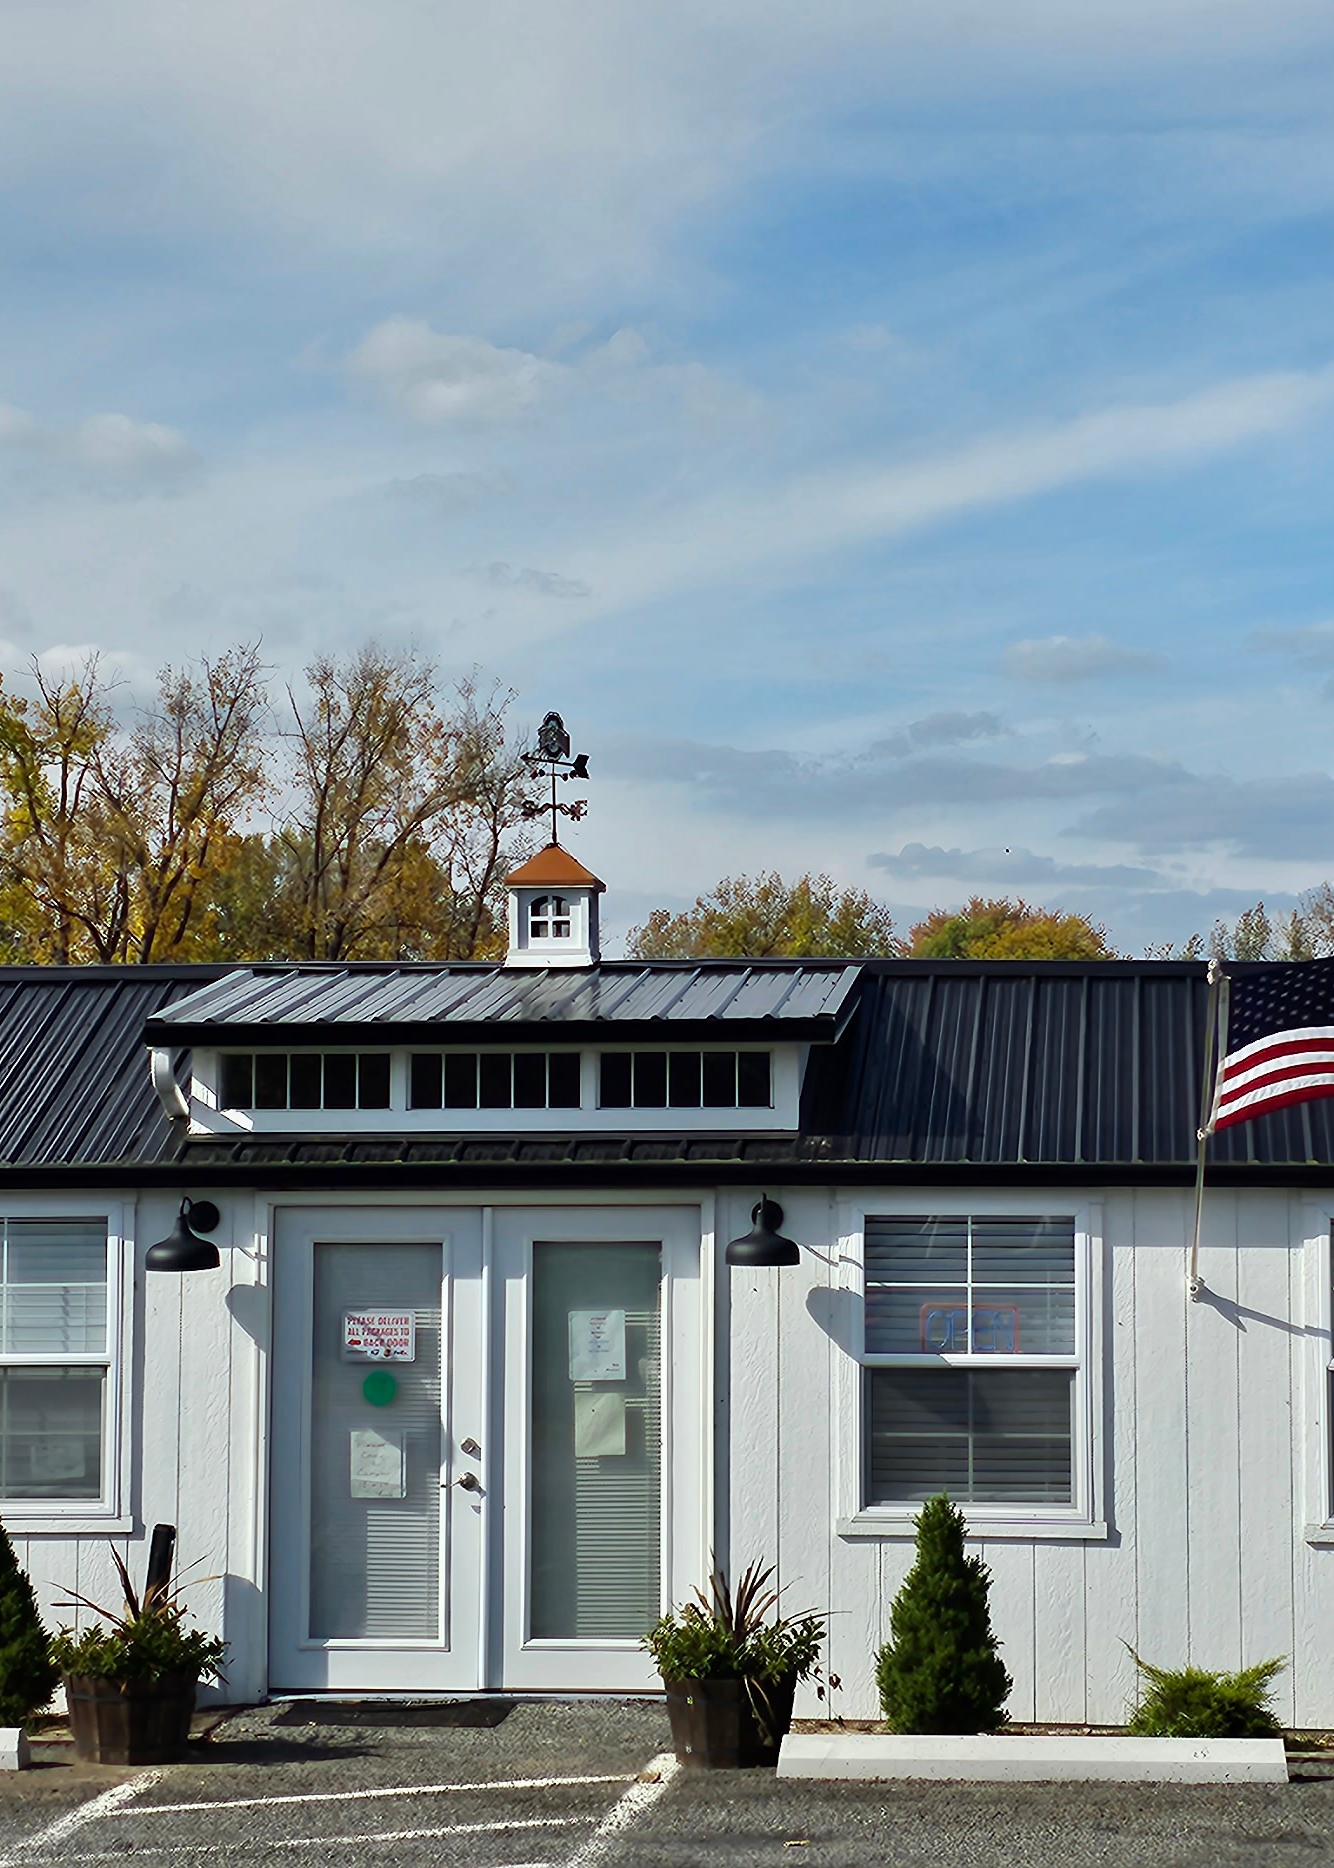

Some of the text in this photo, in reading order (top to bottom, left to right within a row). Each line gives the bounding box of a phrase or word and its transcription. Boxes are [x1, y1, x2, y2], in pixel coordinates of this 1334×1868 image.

[347, 1316, 375, 1325] PLEASE
[348, 1328, 359, 1336] ALL
[925, 1309, 1014, 1351] OPEN
[364, 1338, 409, 1347] BACK DOOR
